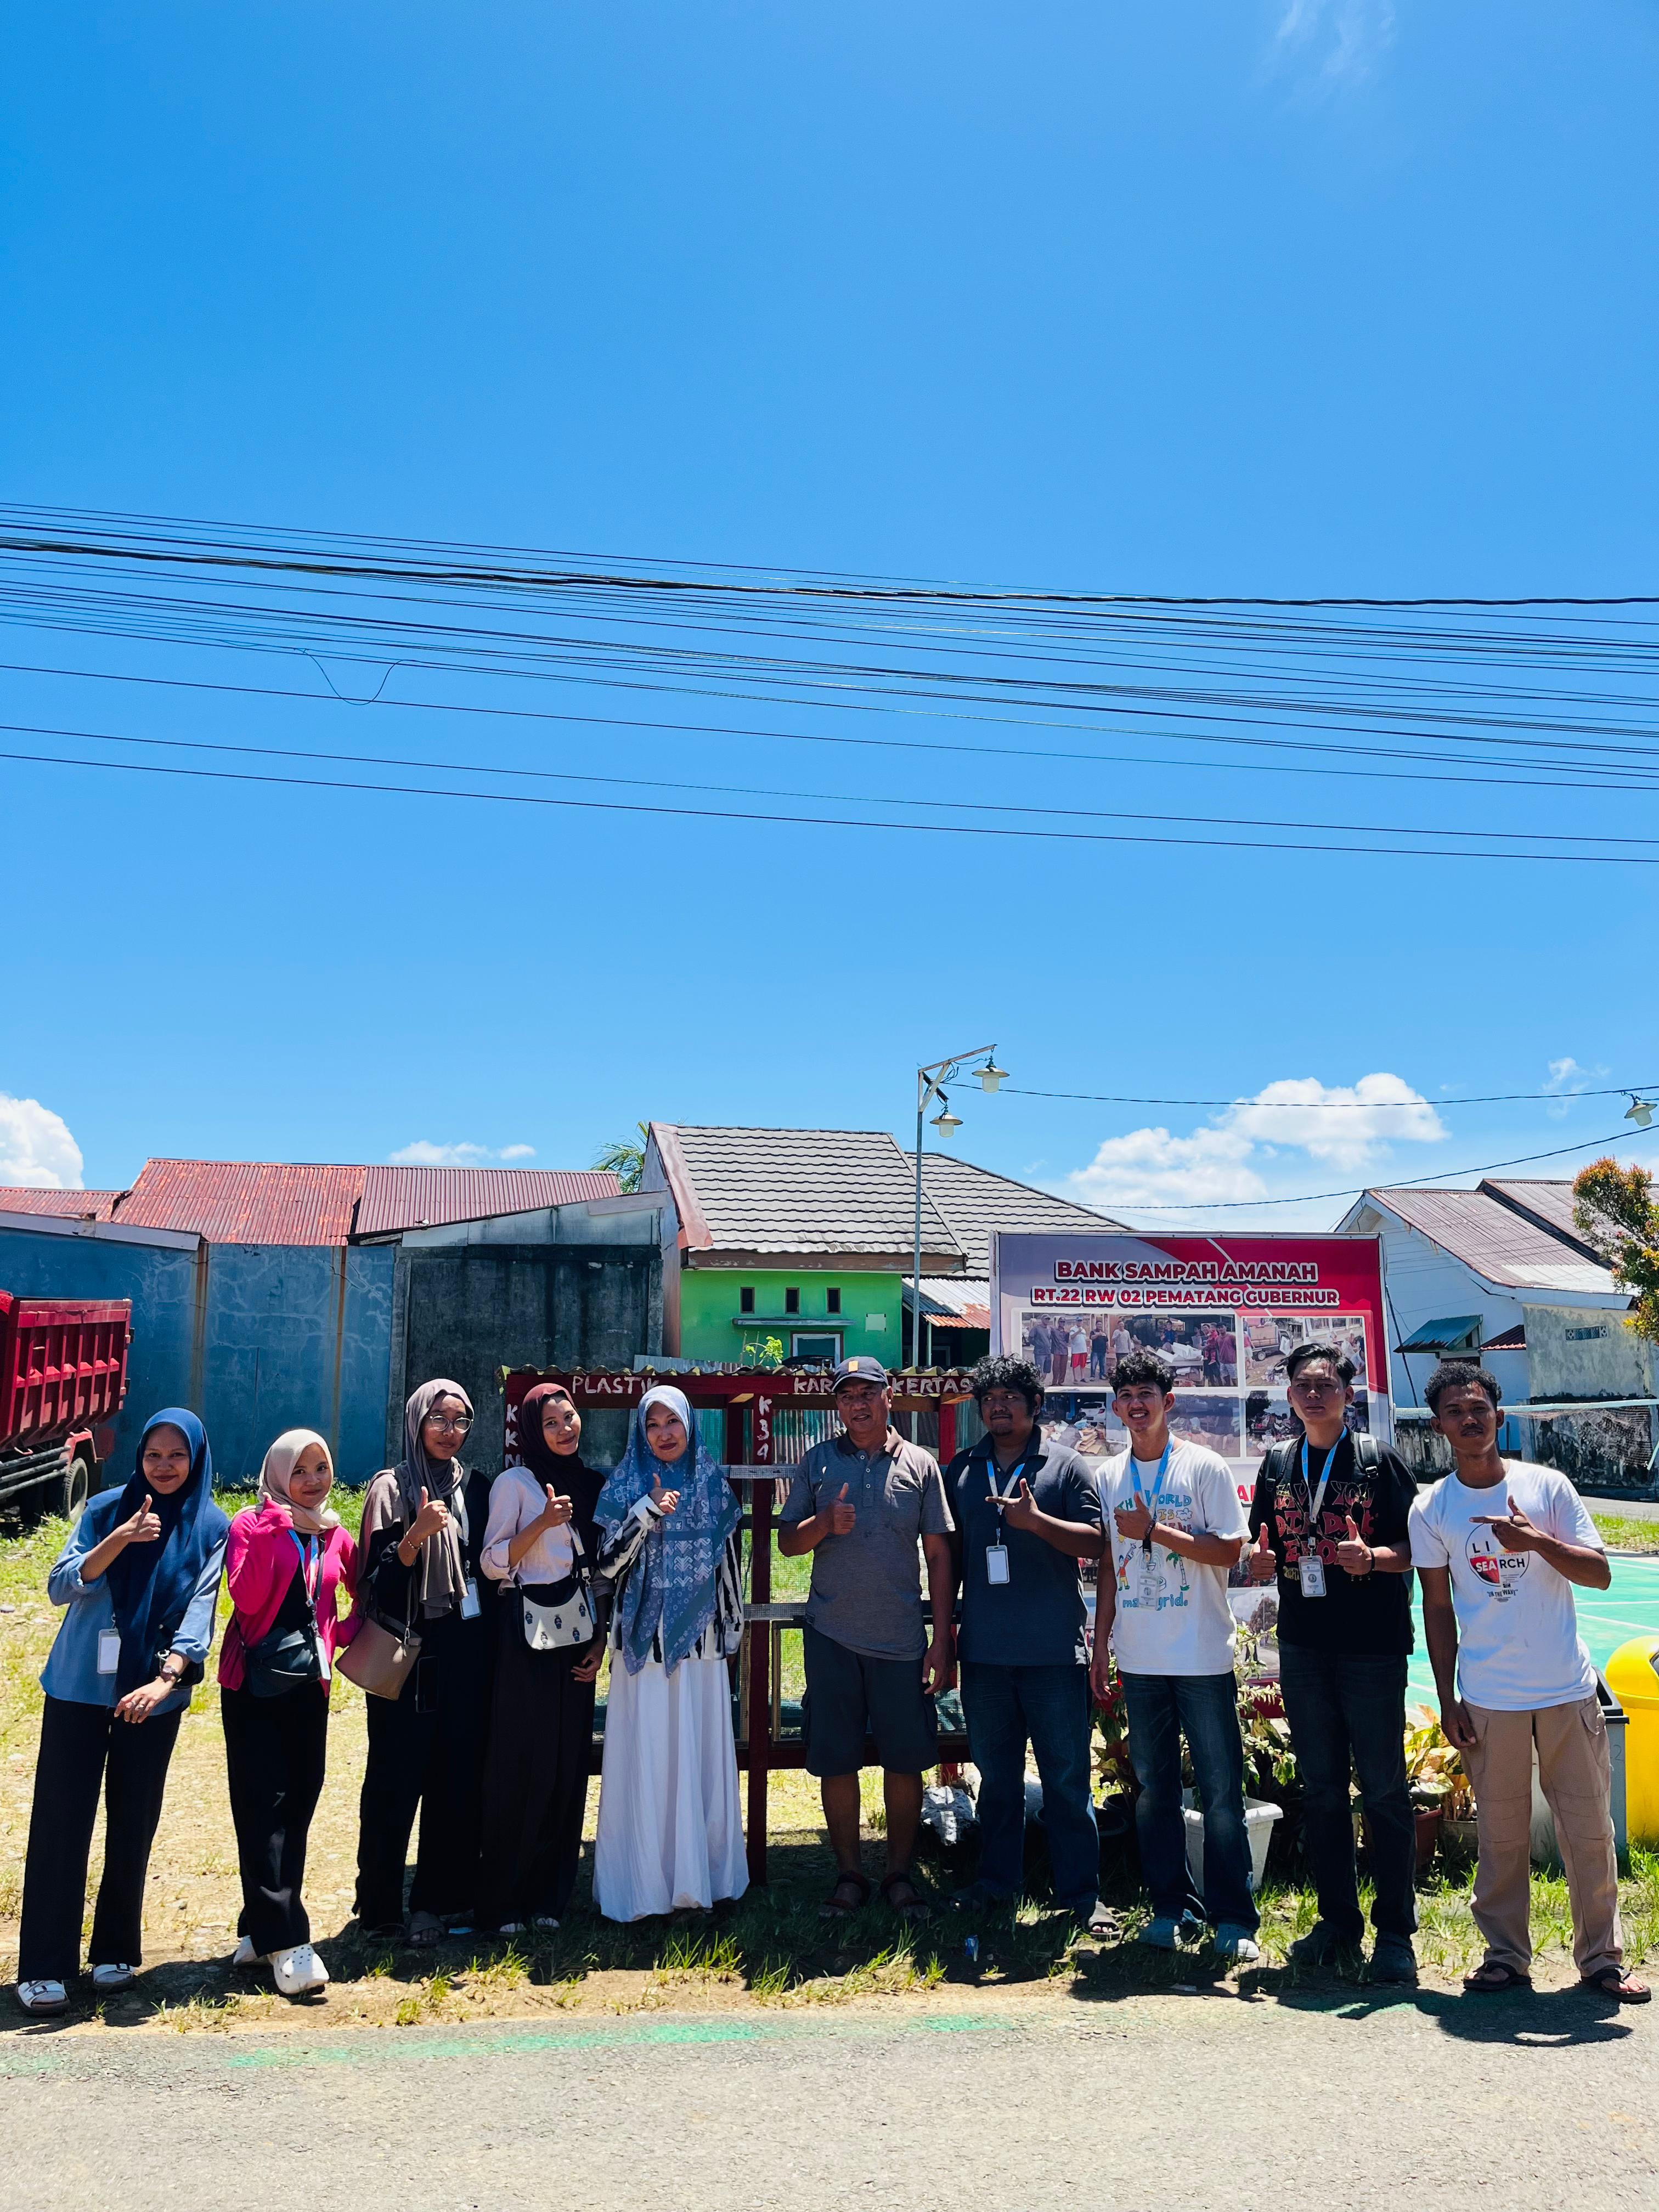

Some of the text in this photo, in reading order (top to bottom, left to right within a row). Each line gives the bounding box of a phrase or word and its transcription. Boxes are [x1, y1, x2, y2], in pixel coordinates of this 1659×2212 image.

[1057, 1261, 1316, 1280] BANK SAMPAH AMANAH
[1034, 1288, 1338, 1304] RT.22 RW 02 PEMATANG GUBERNUR
[572, 1375, 974, 1395] PLASTIK KAR KERTAS
[1157, 1509, 1175, 1521] IS
[1476, 1558, 1525, 1572] SEARCH
